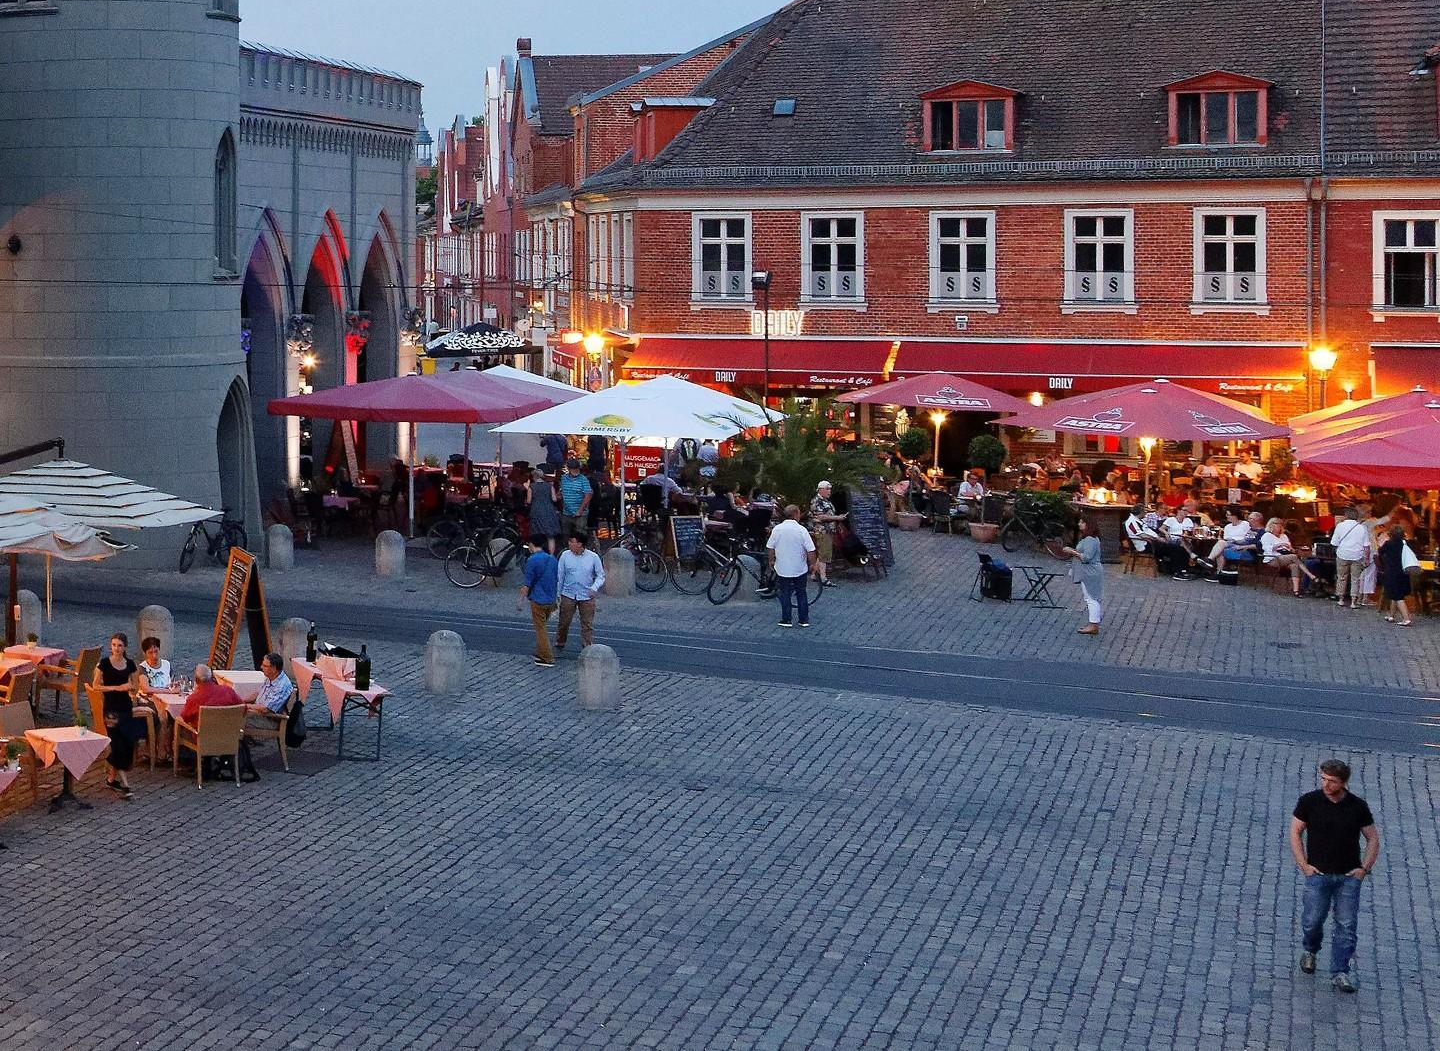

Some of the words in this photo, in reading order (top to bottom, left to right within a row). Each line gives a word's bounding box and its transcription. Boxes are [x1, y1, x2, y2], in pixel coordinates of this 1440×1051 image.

[708, 275, 716, 290] §
[731, 275, 740, 290] §
[817, 275, 826, 291] §
[841, 275, 851, 291] §
[946, 276, 955, 292] §
[972, 276, 981, 292] §
[1081, 276, 1091, 293] §
[1109, 276, 1118, 293] §
[1210, 276, 1220, 292] §
[1240, 276, 1249, 293] §
[751, 310, 804, 337] DAILY
[715, 371, 737, 383] DAILY
[810, 375, 847, 383] Restaurant
[1049, 377, 1074, 389] DAILY
[1219, 382, 1263, 390] Restaurant
[1264, 383, 1272, 391] &
[923, 397, 985, 406] ASTRA
[1062, 419, 1123, 430] ASTRA
[1203, 425, 1252, 434] ASTRA
